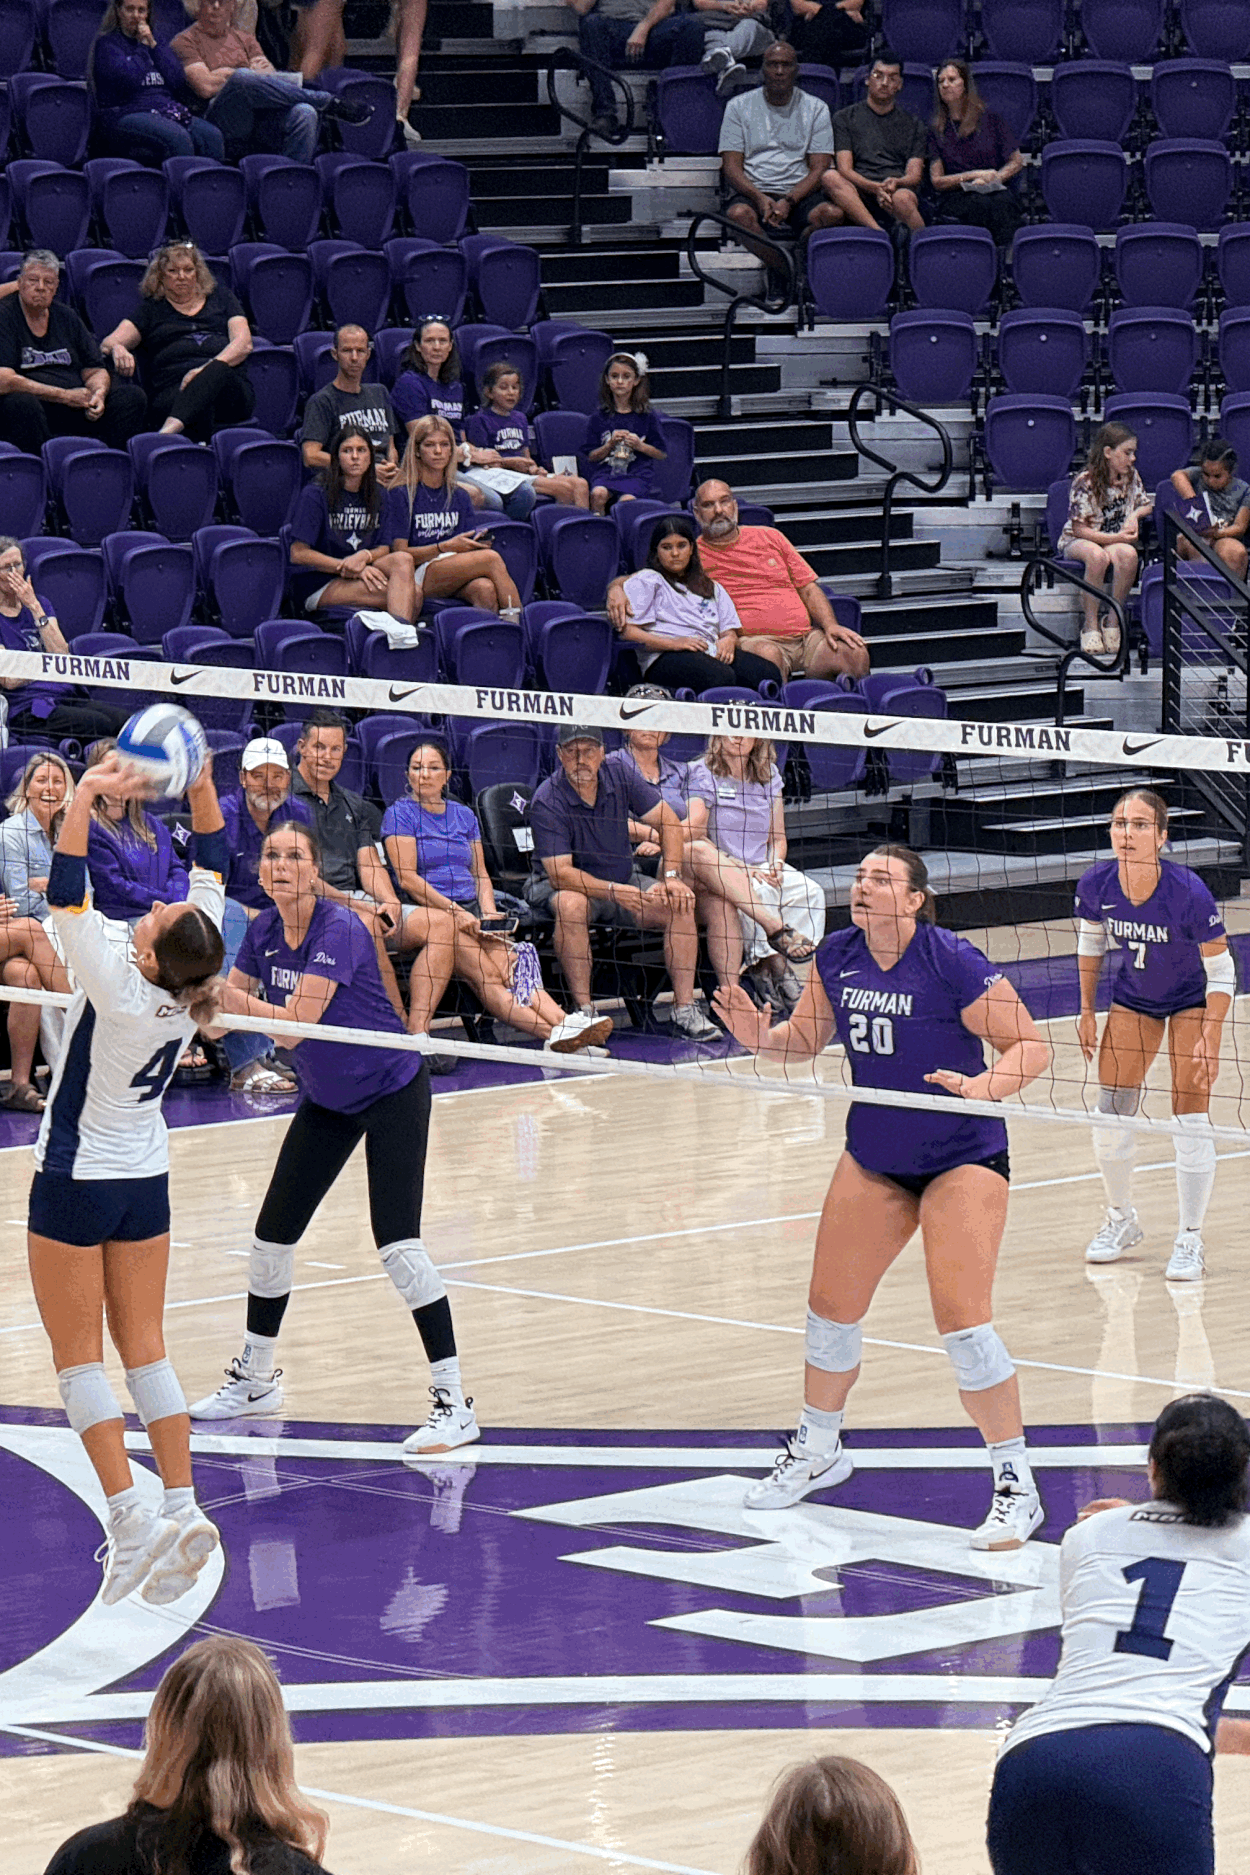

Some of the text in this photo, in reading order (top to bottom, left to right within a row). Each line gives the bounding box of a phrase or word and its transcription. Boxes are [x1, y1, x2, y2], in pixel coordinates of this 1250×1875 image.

[415, 511, 458, 529] FURMAN
[42, 654, 130, 680] FURMAN
[253, 673, 346, 698] FURMAN
[475, 689, 574, 716] FURMAN
[711, 707, 816, 734] FURMAN
[960, 724, 1071, 750] FURMAN
[1107, 917, 1168, 942] FURMAN
[1128, 941, 1146, 969] 7
[840, 987, 913, 1016] FURMAN
[849, 1013, 894, 1055] 20
[129, 1037, 183, 1103] 4
[1113, 1556, 1187, 1662] 1
